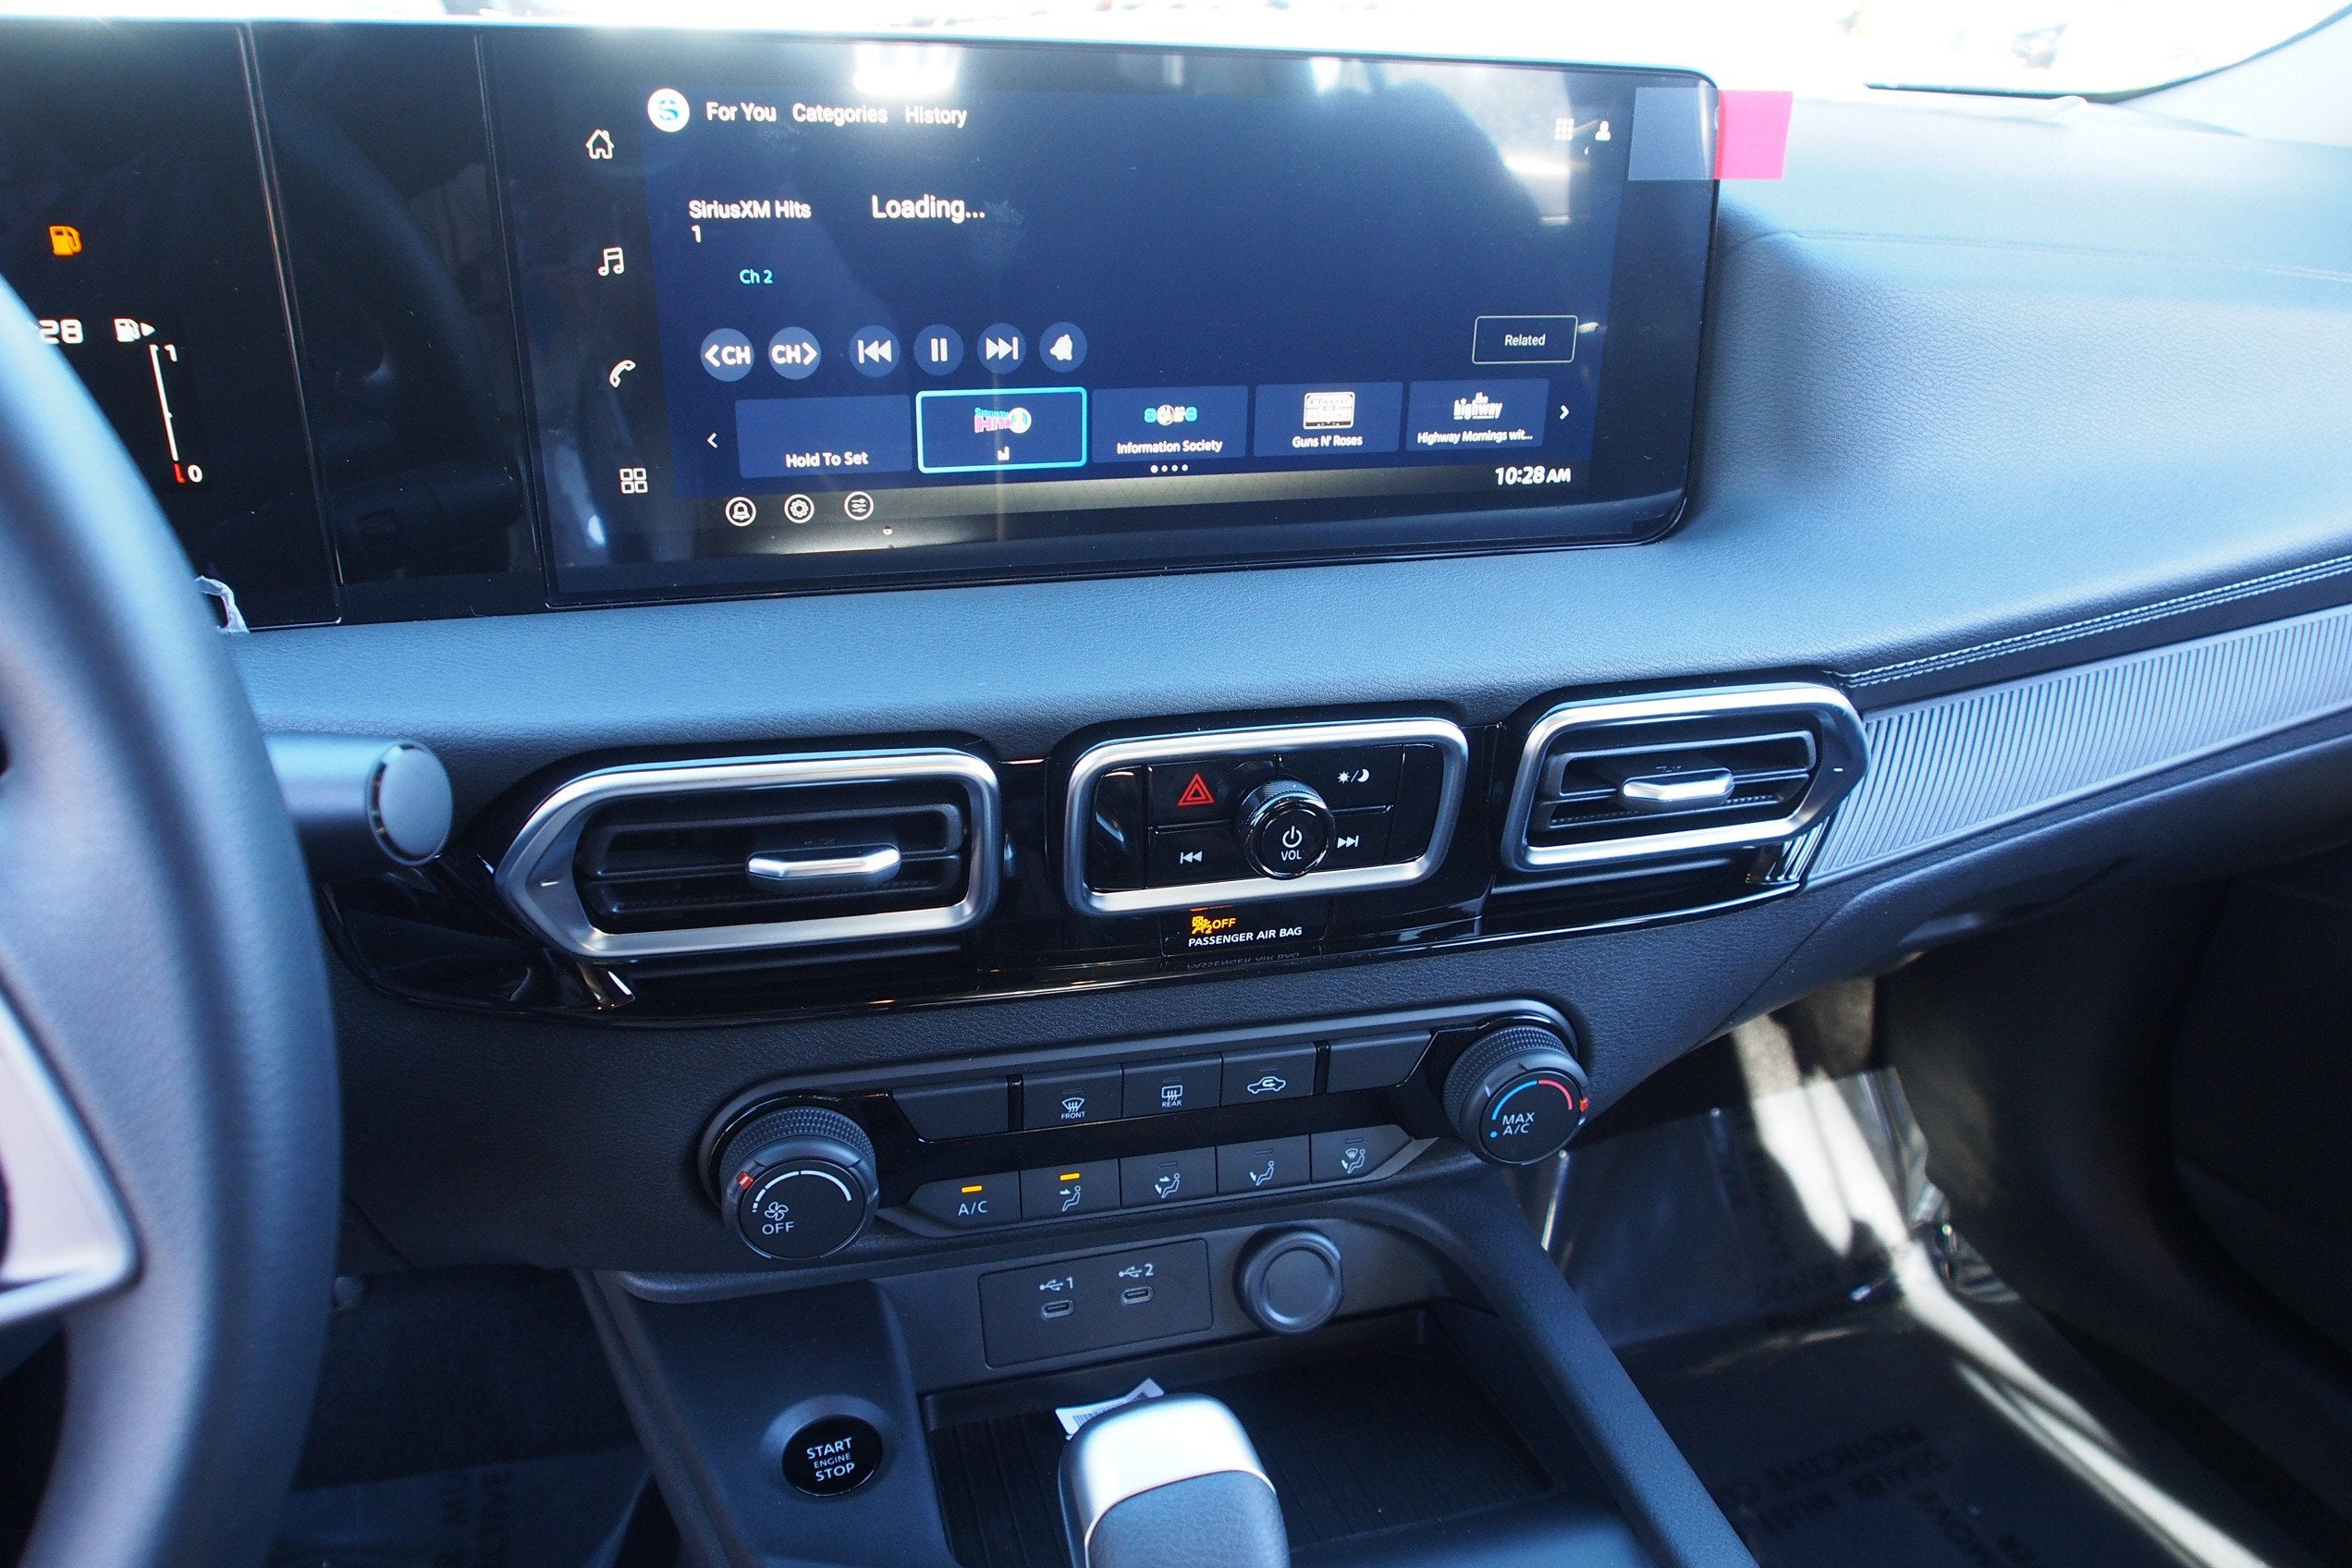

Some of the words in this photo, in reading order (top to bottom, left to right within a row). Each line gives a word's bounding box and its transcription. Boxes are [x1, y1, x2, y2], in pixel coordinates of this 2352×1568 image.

[706, 102, 738, 122] For
[741, 103, 778, 122] You
[792, 103, 888, 127] Categories
[905, 105, 967, 129] History
[689, 200, 771, 218] SiriusXM
[775, 200, 812, 218] Hits
[872, 194, 986, 224] Loading...
[691, 225, 702, 242] 1
[740, 269, 760, 284] Ch
[764, 270, 773, 284] 2
[1504, 333, 1546, 346] Related
[164, 344, 178, 362] 1
[1454, 398, 1502, 420] highway
[1292, 435, 1319, 448] Guns
[1333, 435, 1364, 446] Roses
[1417, 432, 1461, 446] Highway
[1462, 430, 1508, 443] Mornings
[1117, 441, 1181, 455] Information
[1182, 439, 1223, 453] Society
[785, 452, 821, 468] Hold
[822, 452, 842, 466] To
[844, 451, 869, 465] Set
[1495, 465, 1546, 485] 10:28
[1546, 468, 1572, 484] AM
[1280, 850, 1303, 862] VOL
[1212, 918, 1237, 930] OFF
[1188, 932, 1254, 947] PASSENGER
[1256, 929, 1277, 940] AIR
[1279, 926, 1303, 938] BAG
[1061, 1111, 1086, 1120] FRONT
[1502, 1112, 1536, 1125] MAX
[1502, 1123, 1530, 1136] A/C
[958, 1201, 988, 1216] A/C
[762, 1221, 795, 1235] OFF
[1145, 1264, 1154, 1277] 2
[1066, 1277, 1073, 1290] 1
[806, 1437, 852, 1460] START
[814, 1452, 851, 1469] ENGINE
[815, 1462, 855, 1482] STOP
